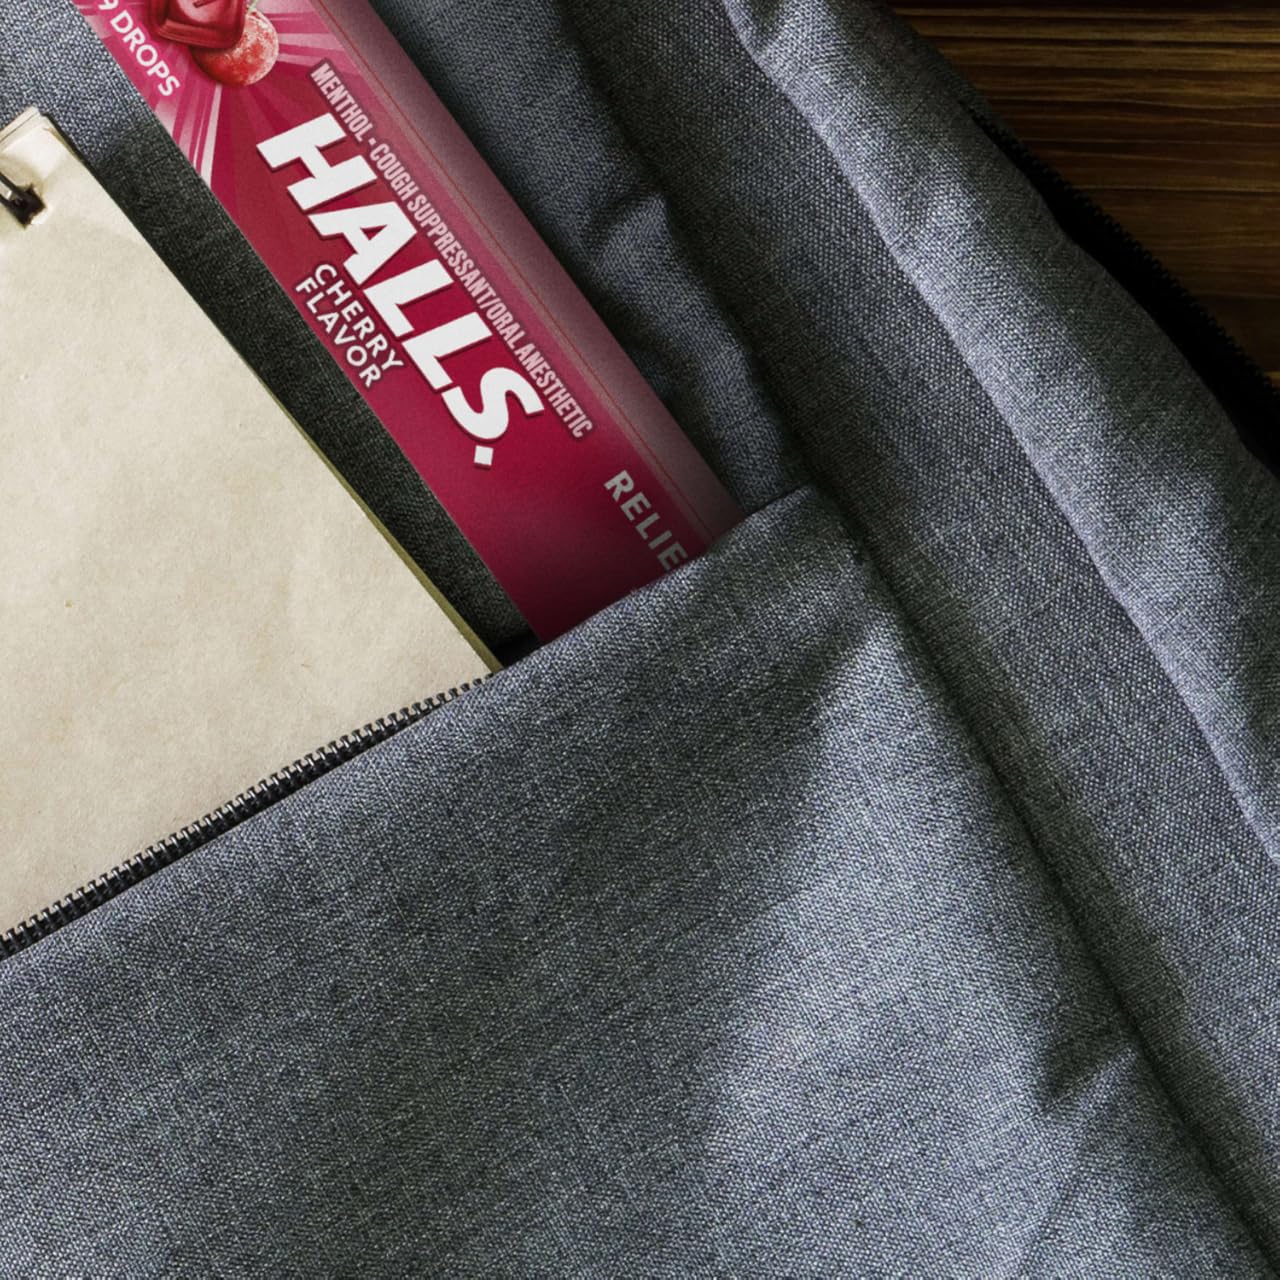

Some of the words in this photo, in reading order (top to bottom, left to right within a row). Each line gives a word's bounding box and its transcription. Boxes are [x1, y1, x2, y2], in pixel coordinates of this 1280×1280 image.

[110, 11, 181, 97] DROPS
[310, 62, 373, 142] MENTHOL
[369, 143, 419, 201] COUGH
[515, 343, 593, 438] ANESTHETIC
[295, 277, 381, 387] FLAVOR
[315, 264, 404, 370] CHERRY
[603, 470, 688, 570] RELIE
